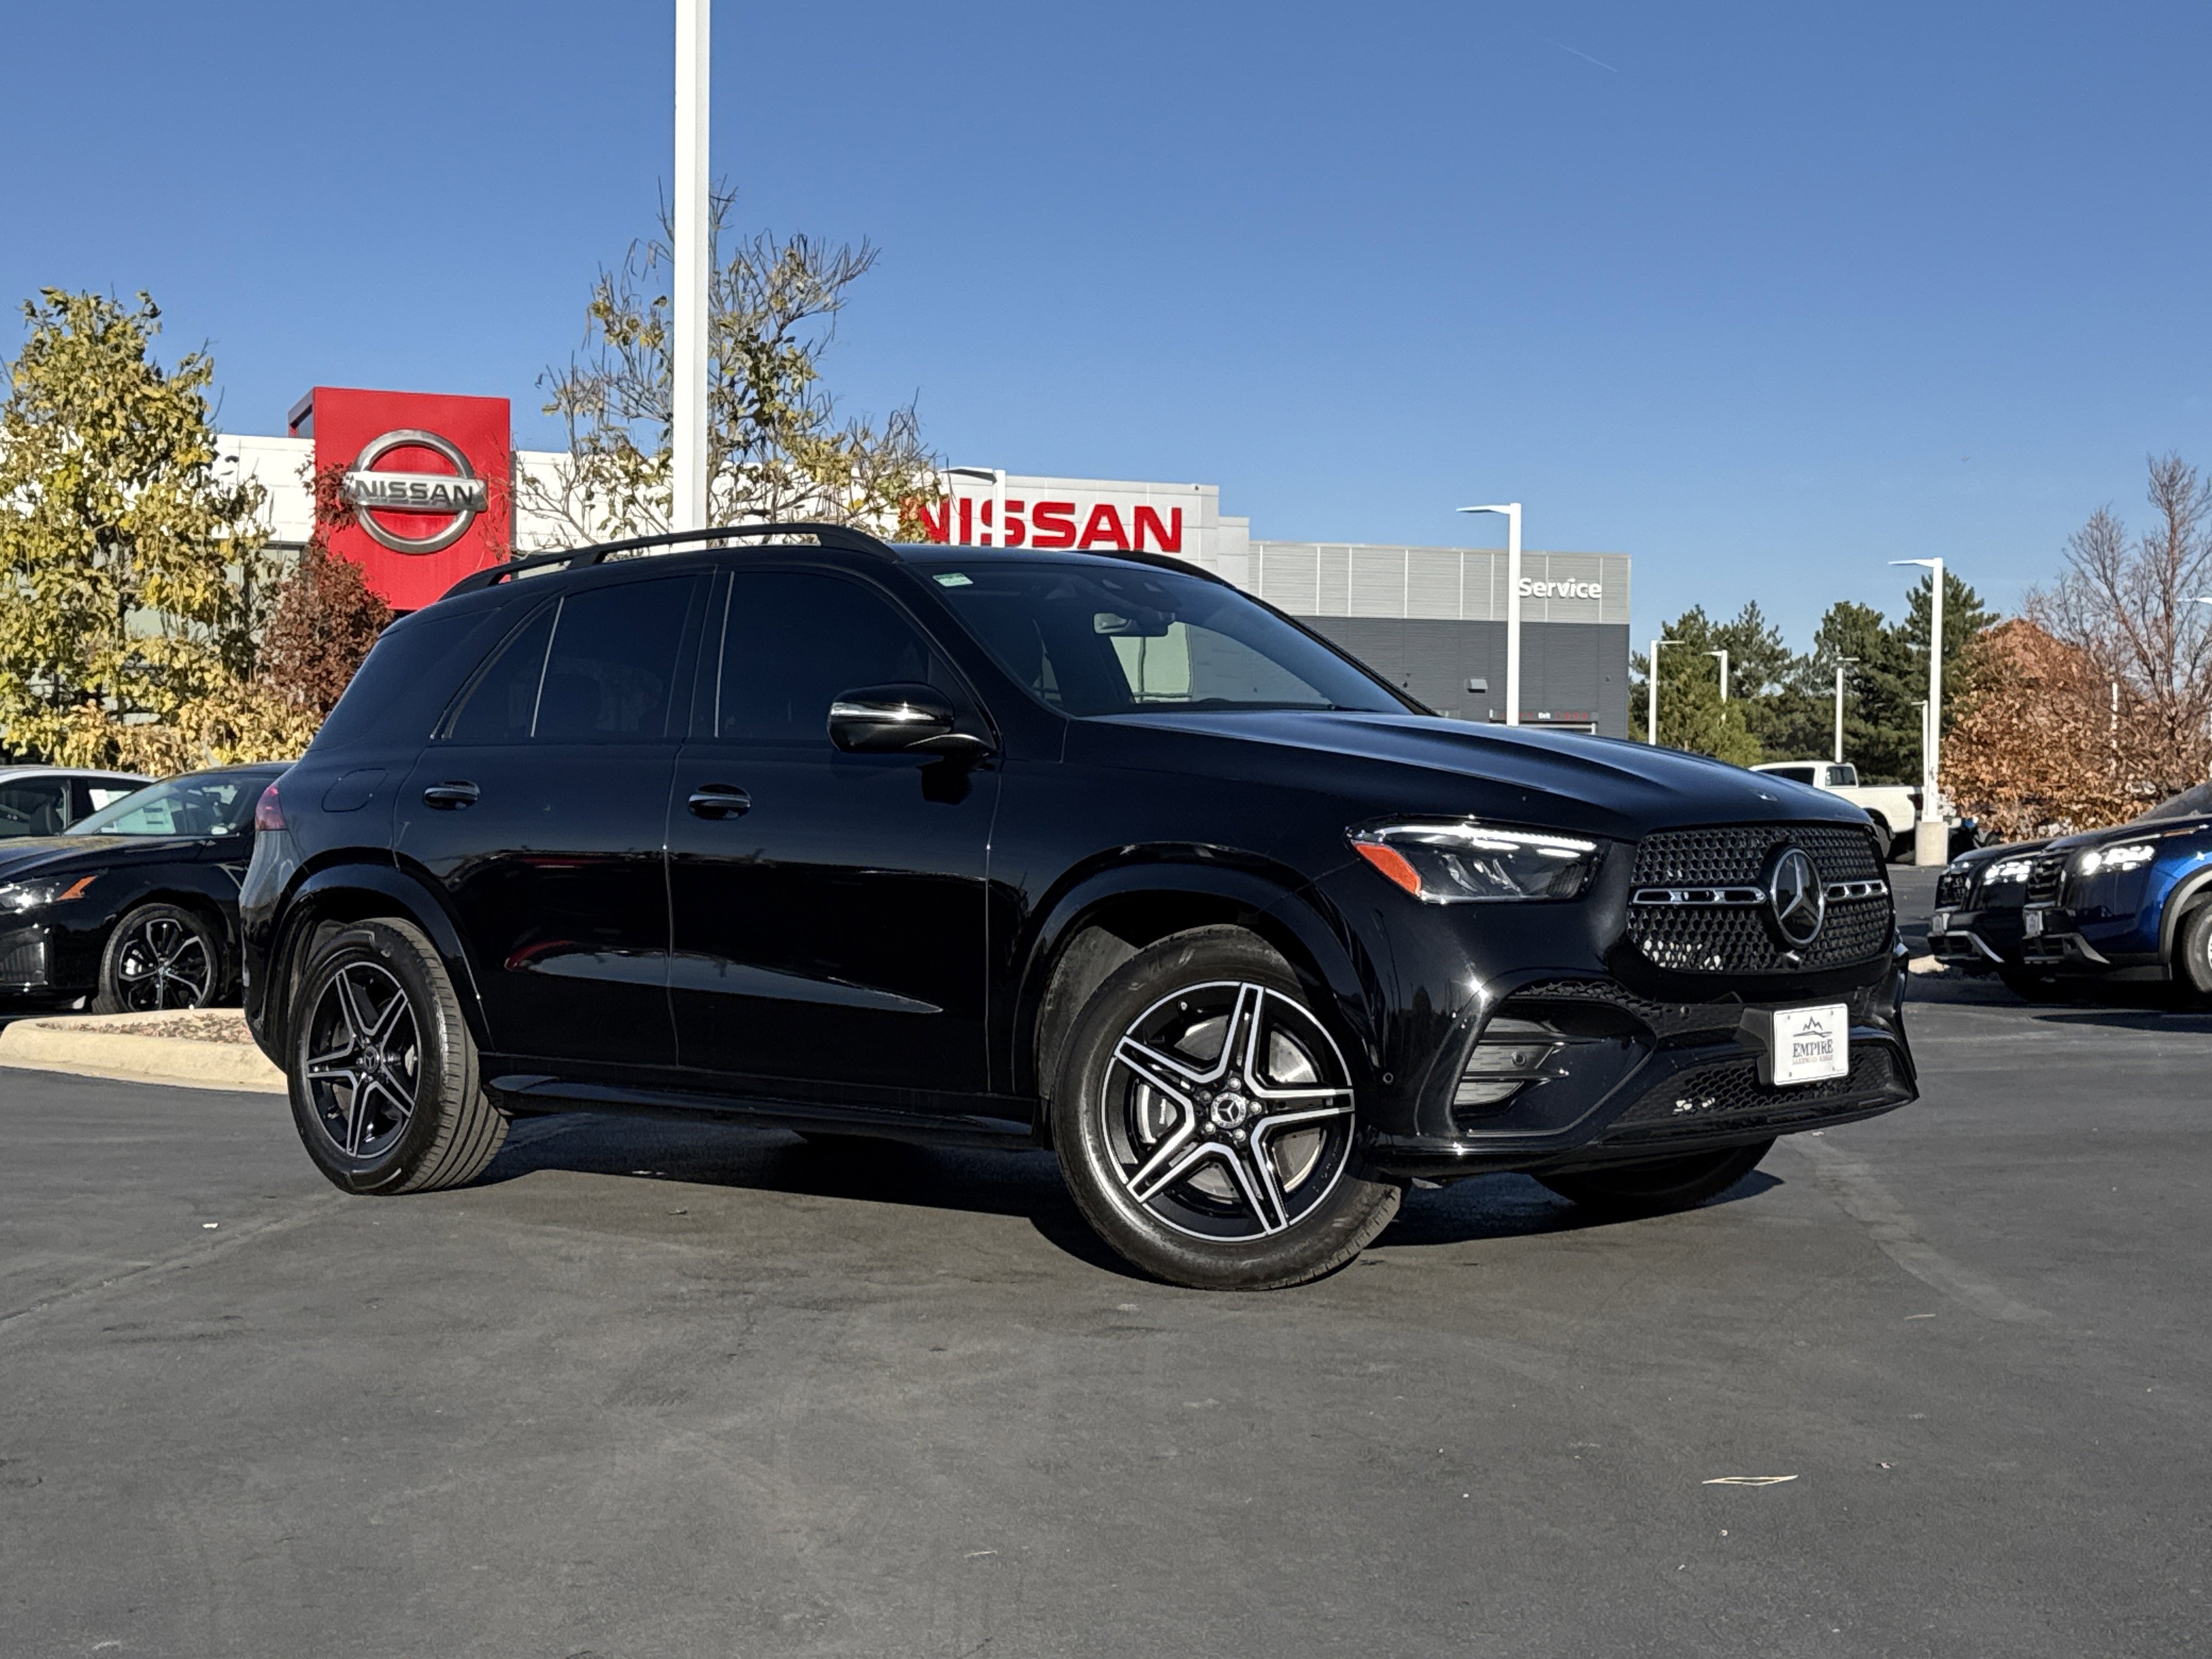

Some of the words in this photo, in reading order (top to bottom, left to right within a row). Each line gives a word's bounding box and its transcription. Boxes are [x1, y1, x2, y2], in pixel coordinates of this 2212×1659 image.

[355, 479, 473, 505] NISSAN
[1519, 578, 1602, 599] Service
[1792, 1039, 1833, 1058] EMPIRE
